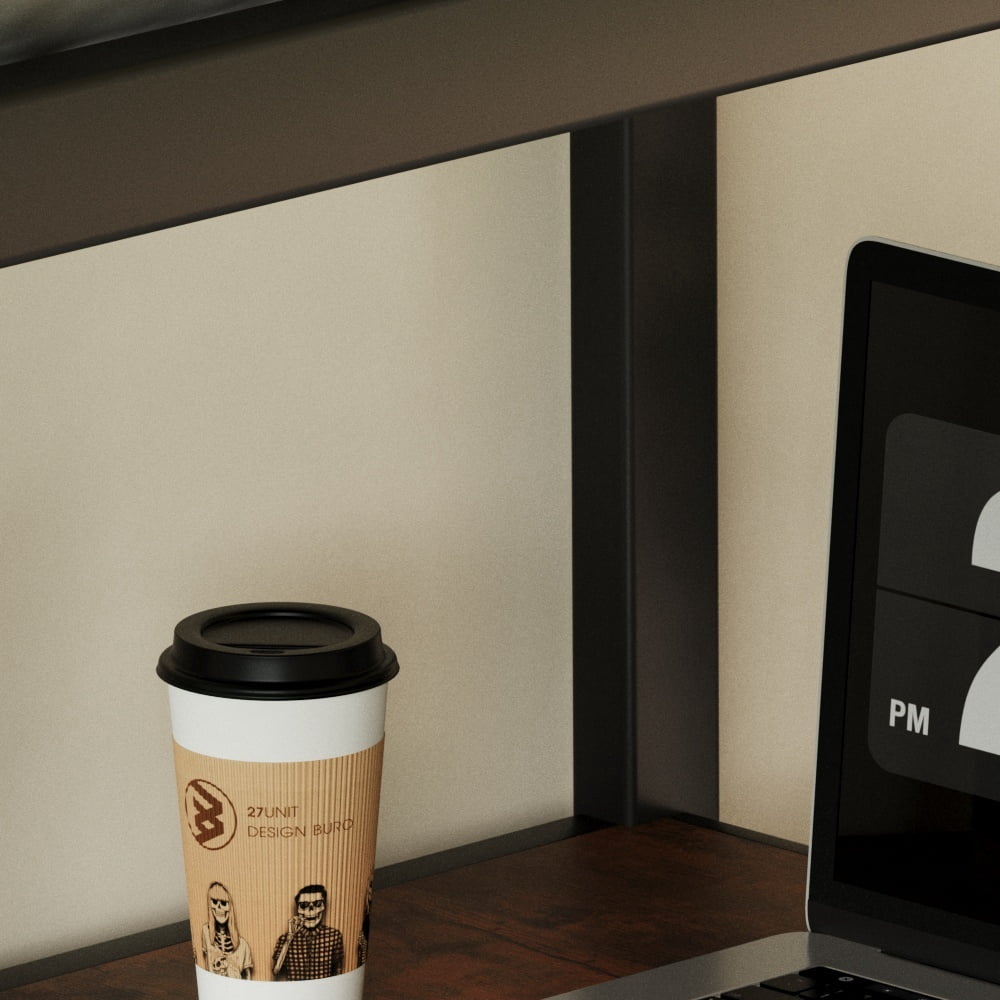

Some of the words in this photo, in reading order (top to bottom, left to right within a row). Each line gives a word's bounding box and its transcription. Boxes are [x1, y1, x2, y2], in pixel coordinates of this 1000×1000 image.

[890, 699, 929, 735] PM
[247, 805, 299, 818] 27UNIT
[247, 825, 306, 838] DESIGN
[313, 818, 354, 836] BURO
